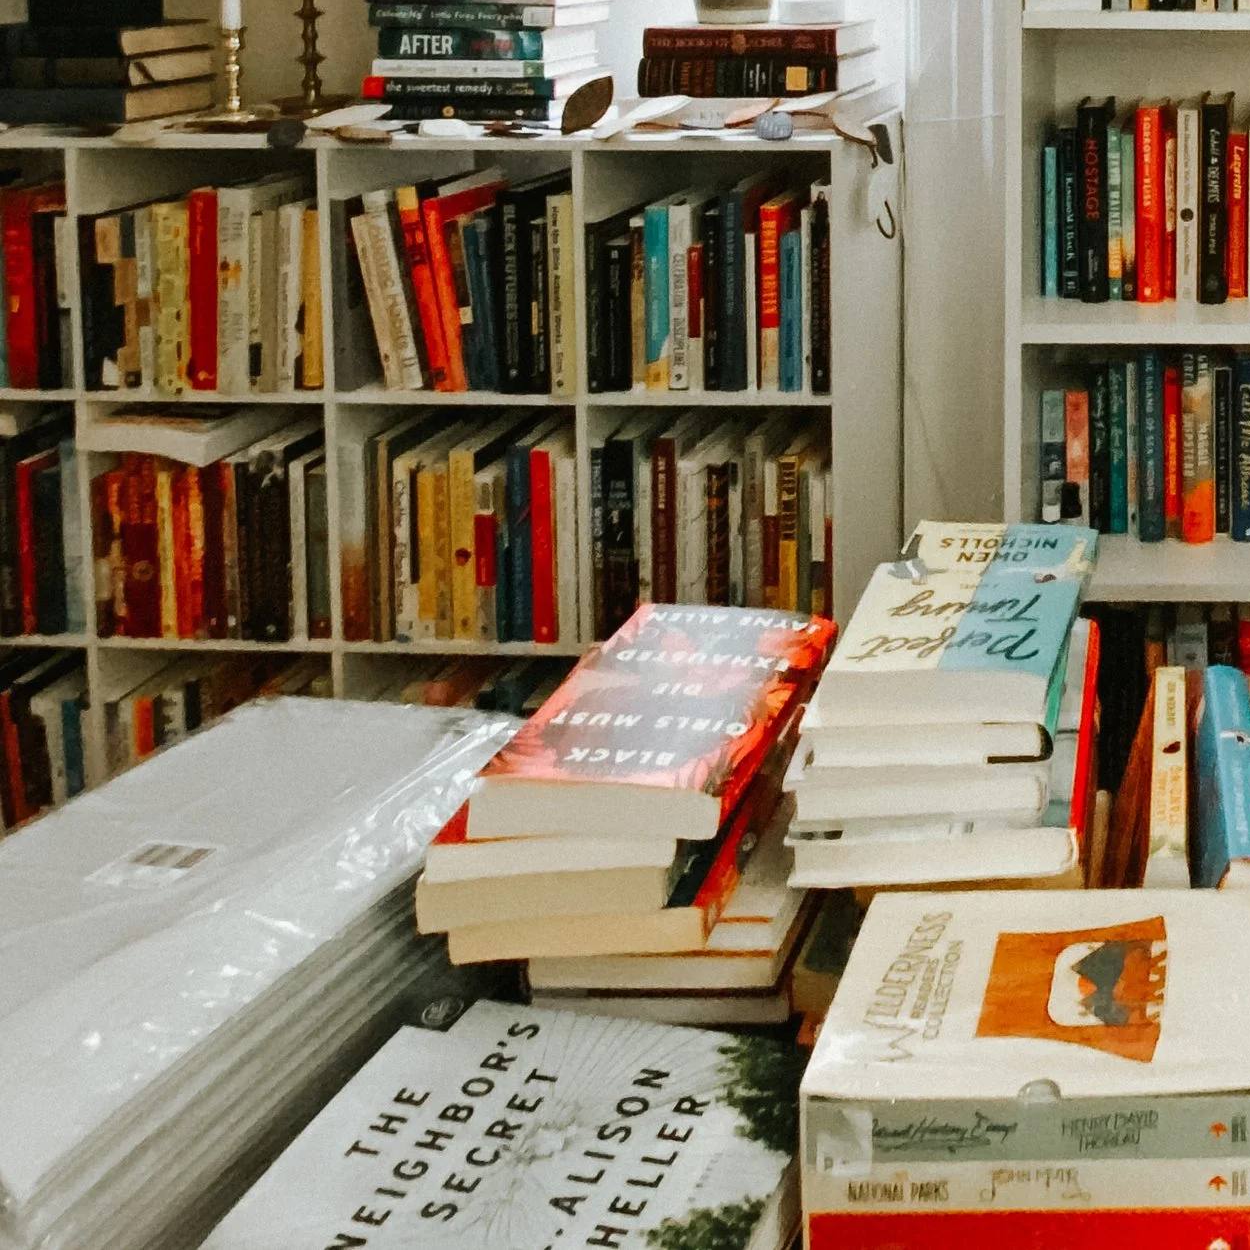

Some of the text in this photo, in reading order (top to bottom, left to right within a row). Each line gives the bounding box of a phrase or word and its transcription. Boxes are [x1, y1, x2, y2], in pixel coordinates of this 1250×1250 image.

[477, 12, 523, 25] Everywher
[400, 34, 453, 55] AFTER
[386, 80, 493, 96] the sweetest remedy
[1085, 138, 1099, 220] HOSTAGE
[552, 246, 560, 272] Bible
[1065, 231, 1075, 261] BACK
[503, 204, 518, 324] BLACK FUTURES
[553, 274, 562, 312] Actually
[554, 314, 563, 344] Works
[673, 317, 685, 368] DISCIPLINE
[1146, 376, 1155, 412] ISLAND
[1146, 435, 1155, 454] SEA
[940, 537, 1059, 550] NICHOLLS
[956, 551, 1029, 563] OWEN
[889, 589, 1041, 622] Timing
[650, 611, 821, 635] JAYNE ALLEN
[847, 626, 1040, 662] Perfect
[616, 650, 791, 672] EXHAUSTED
[652, 682, 704, 696] DIE
[549, 710, 748, 736] GIRLS MUST
[563, 747, 677, 767] BLACK
[862, 911, 953, 1063] WILDERNESS
[910, 957, 939, 1019] READERS
[922, 939, 965, 1040] COLLECTION
[324, 1021, 541, 1250] NEIGHBOR'S
[344, 1085, 430, 1157] THE
[420, 1067, 559, 1222] SECRET
[548, 1067, 671, 1217] ALISON
[586, 1093, 711, 1249] HELLER
[910, 1180, 949, 1202] PARKS
